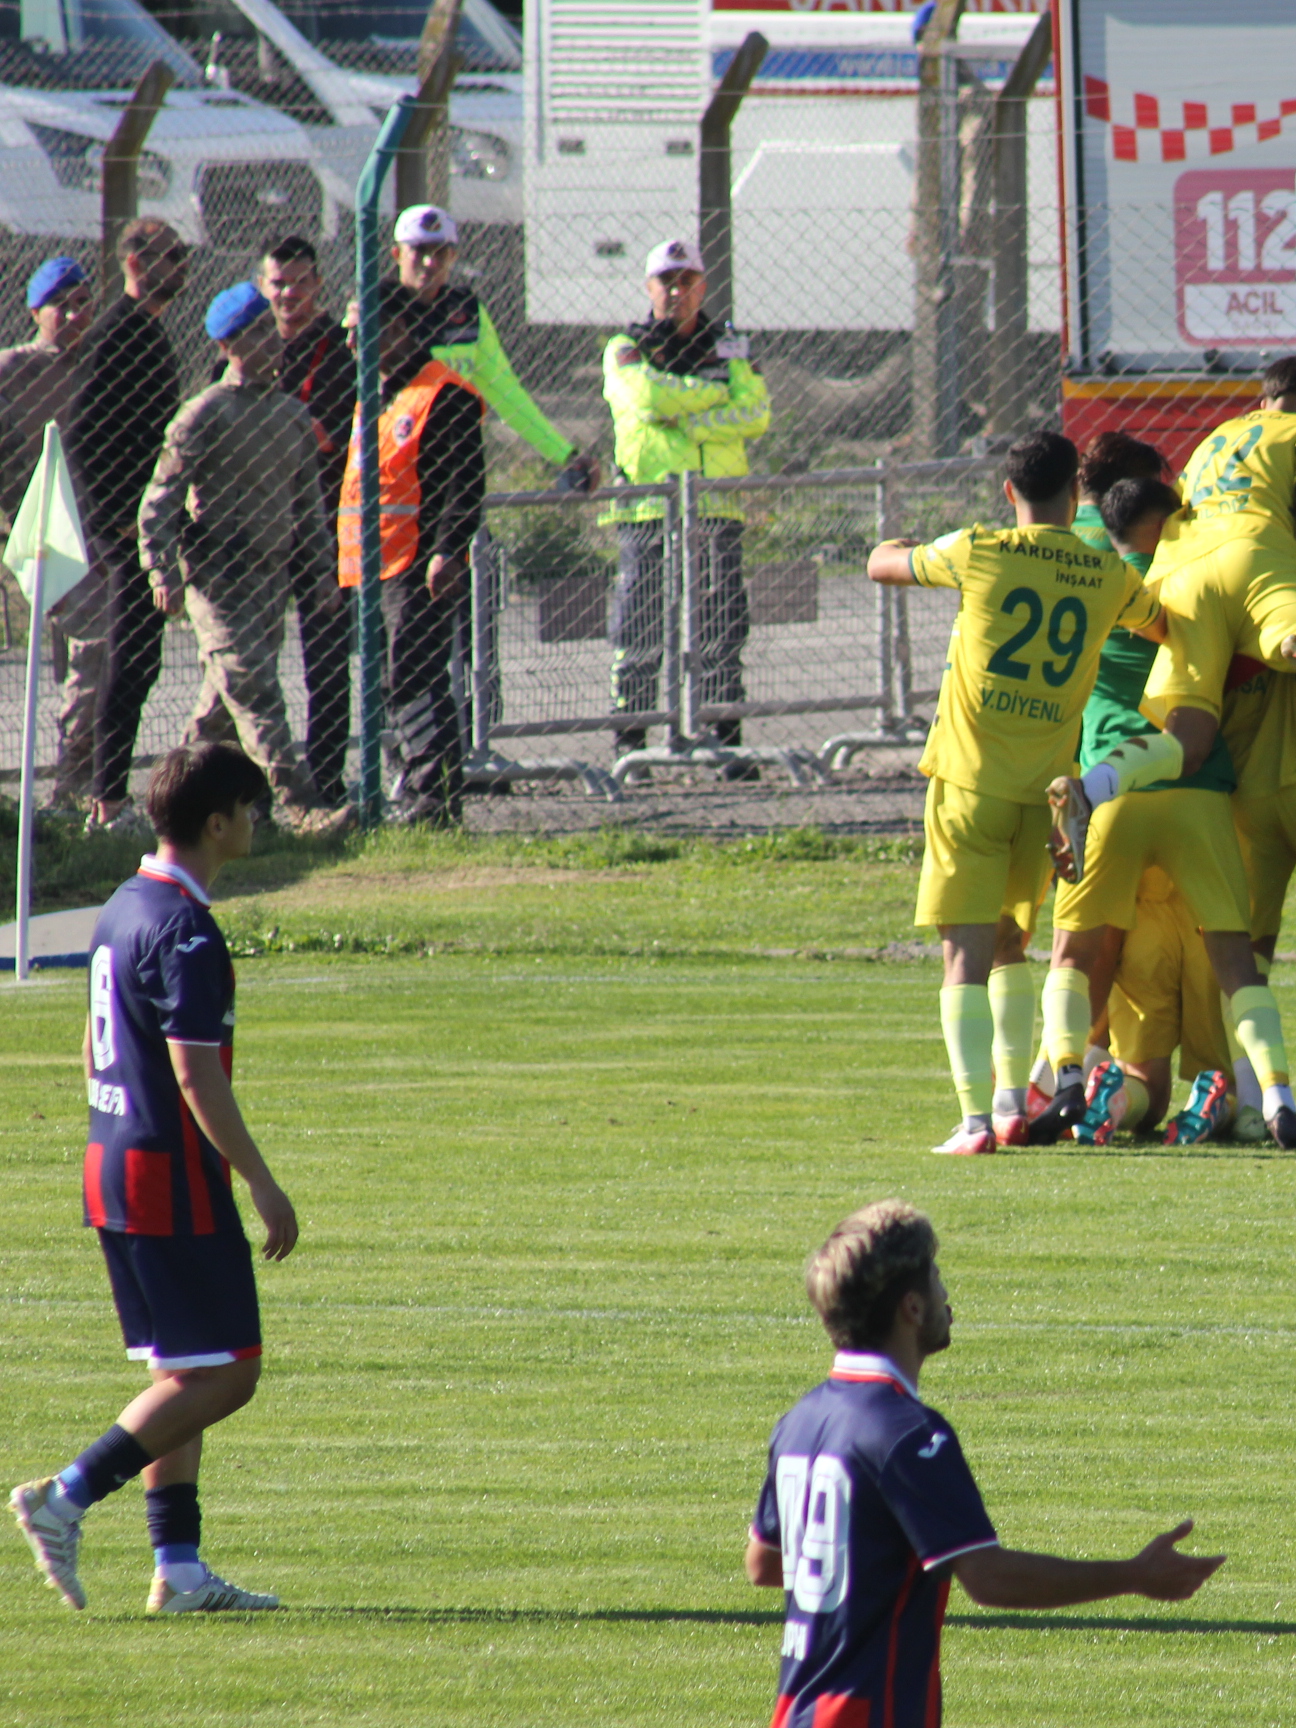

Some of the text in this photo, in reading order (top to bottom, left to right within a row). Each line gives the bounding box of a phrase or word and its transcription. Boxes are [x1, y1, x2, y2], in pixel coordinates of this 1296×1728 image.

[1000, 540, 1103, 570] KARDEŞLER
[1056, 568, 1103, 589] İNŞAAT
[986, 586, 1088, 687] 29
